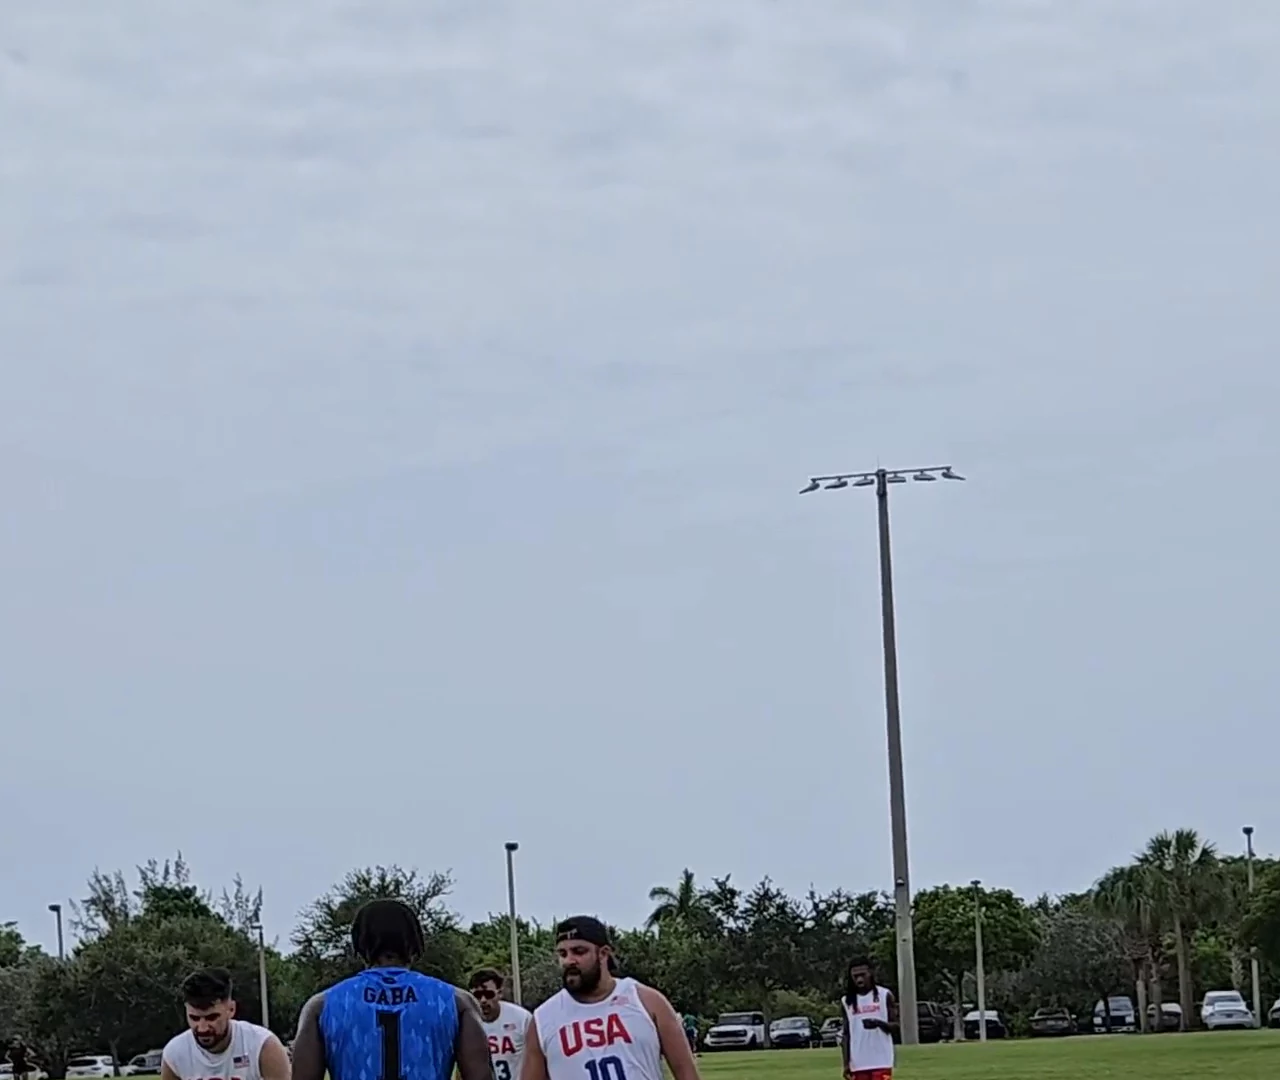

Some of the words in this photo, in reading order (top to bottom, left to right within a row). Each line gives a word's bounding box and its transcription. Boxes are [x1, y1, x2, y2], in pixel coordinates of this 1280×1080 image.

[363, 985, 418, 1006] GABA
[488, 1036, 516, 1054] SA
[559, 1013, 632, 1057] USA
